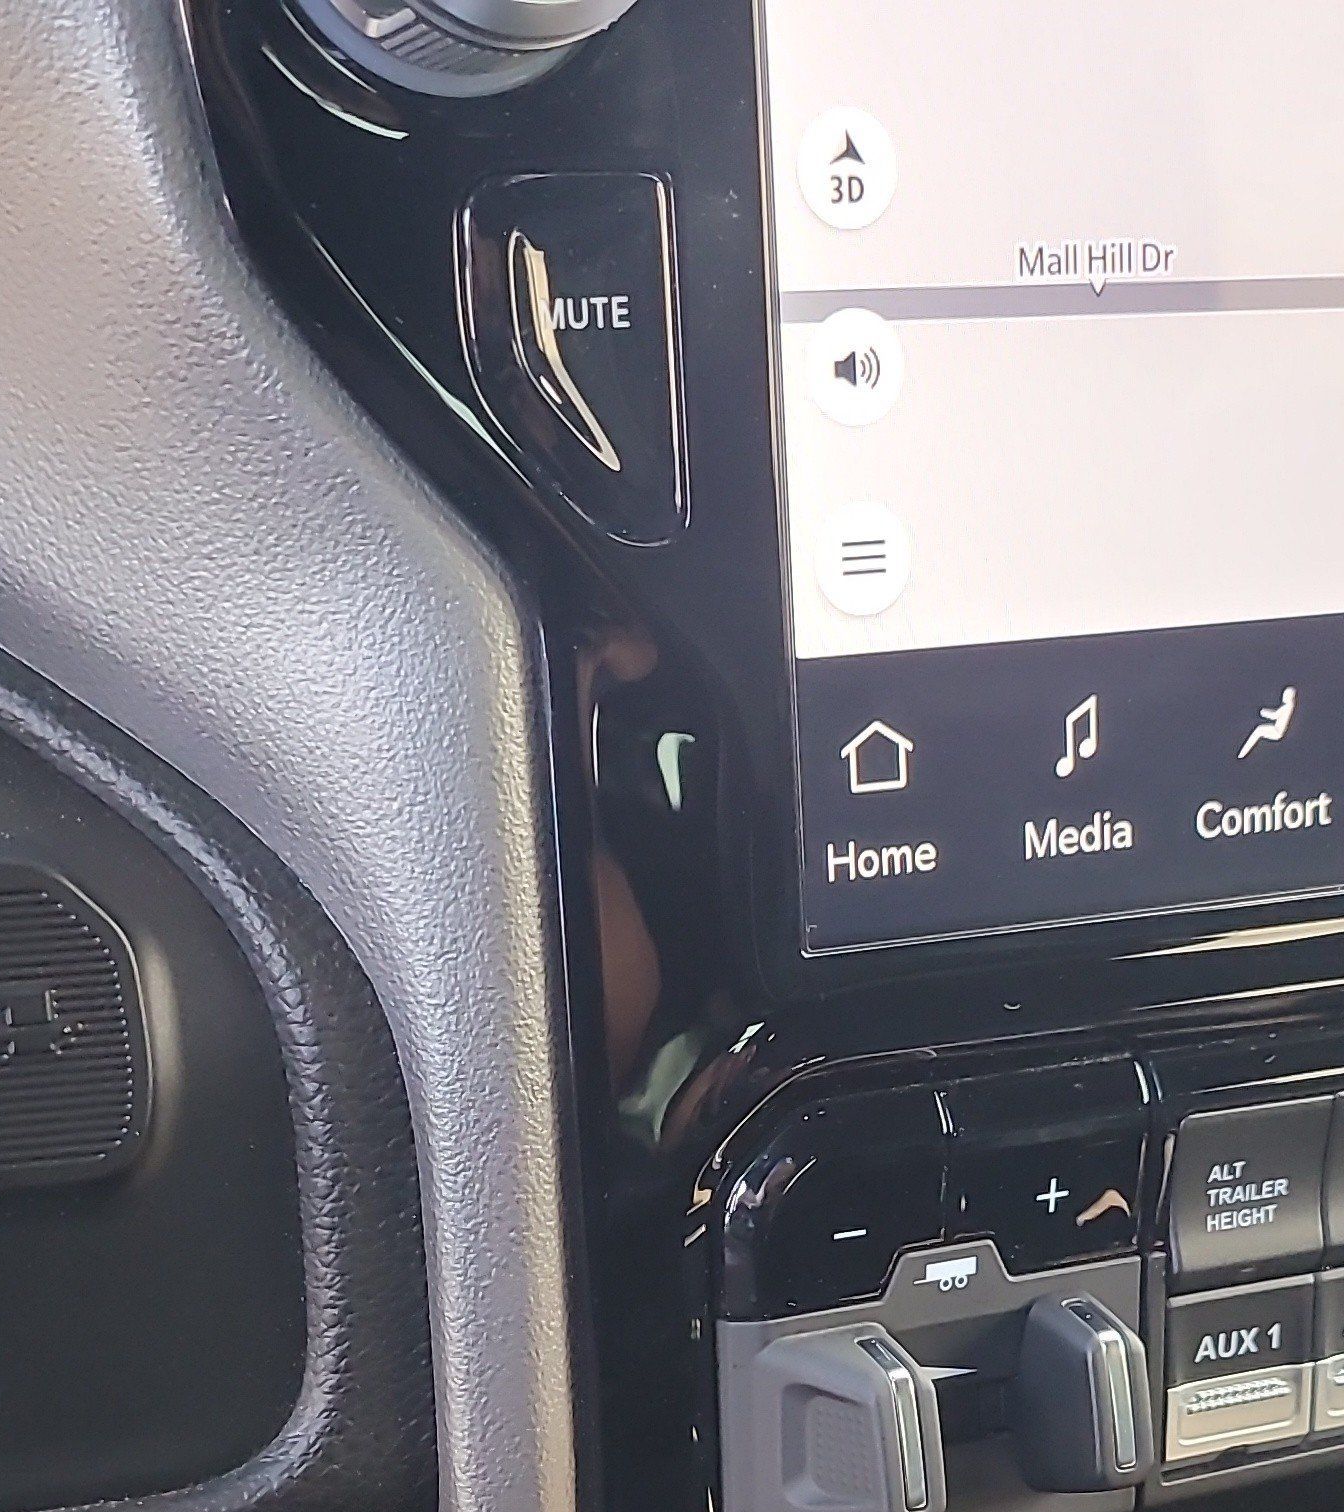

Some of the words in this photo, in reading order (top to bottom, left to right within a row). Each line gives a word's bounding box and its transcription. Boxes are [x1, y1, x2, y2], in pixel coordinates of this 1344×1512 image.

[830, 175, 865, 204] 3D
[1018, 246, 1078, 277] Mall
[1088, 242, 1133, 275] Hill
[1142, 243, 1174, 272] Dr
[539, 295, 631, 330] MUTE
[1195, 790, 1333, 840] Comfort
[1023, 810, 1134, 860] Media
[826, 841, 938, 883] Home
[1206, 1160, 1247, 1184] ALT
[1206, 1177, 1290, 1208] TRAILER
[1206, 1203, 1278, 1233] HEIGHT
[1194, 1326, 1261, 1364] AUX
[1266, 1322, 1283, 1350] 1
